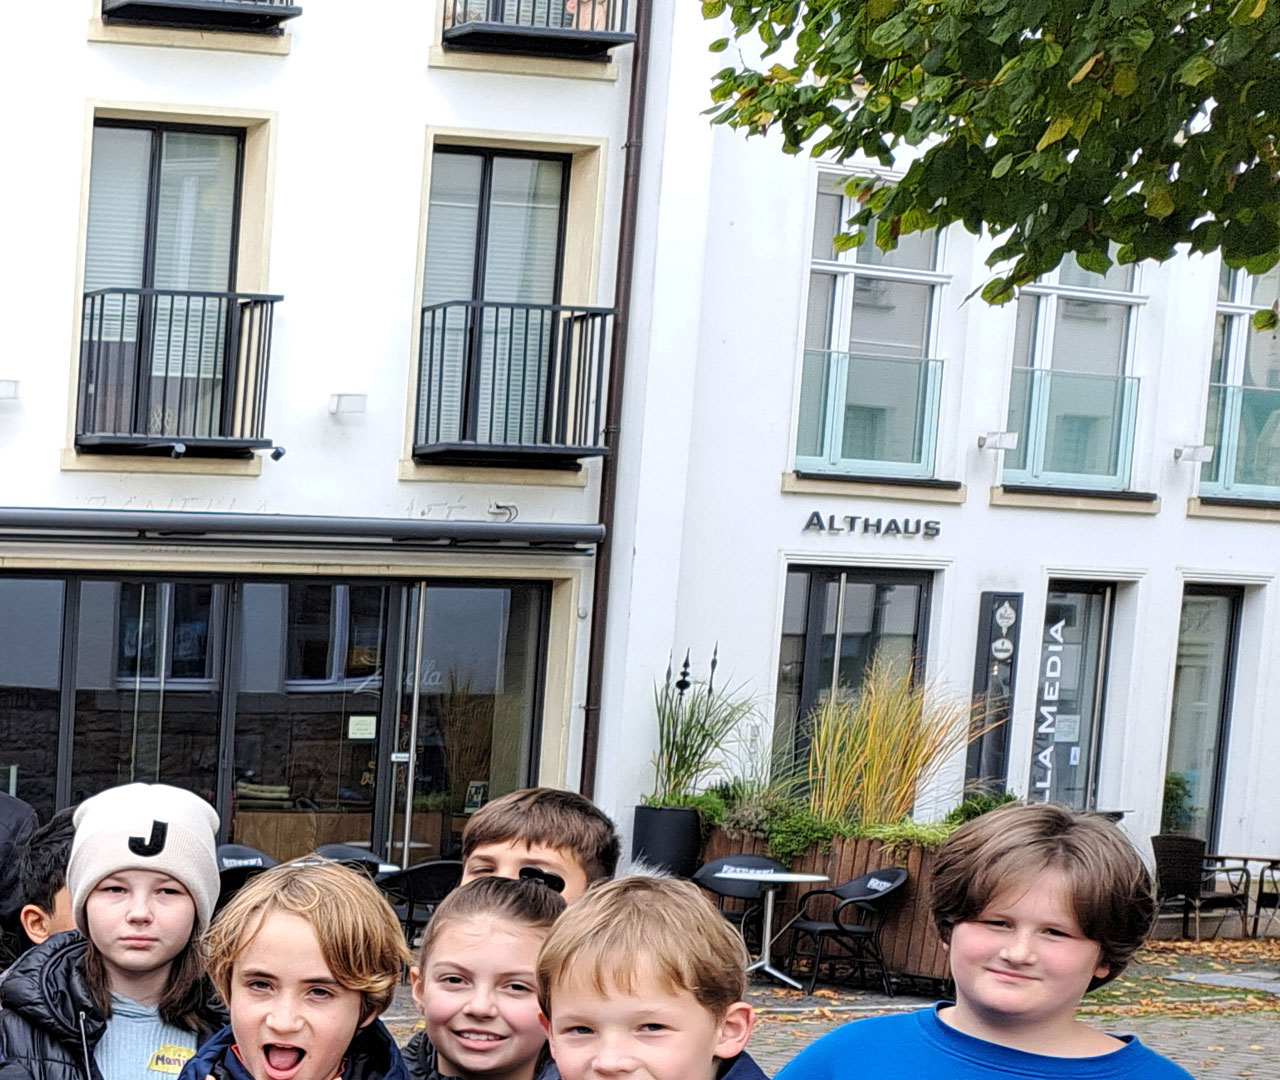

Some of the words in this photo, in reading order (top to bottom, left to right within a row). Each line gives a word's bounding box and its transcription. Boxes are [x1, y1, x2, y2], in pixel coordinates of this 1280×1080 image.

[802, 510, 941, 537] ALTHAUS
[1038, 618, 1066, 733] MEDIA
[127, 819, 169, 858] J
